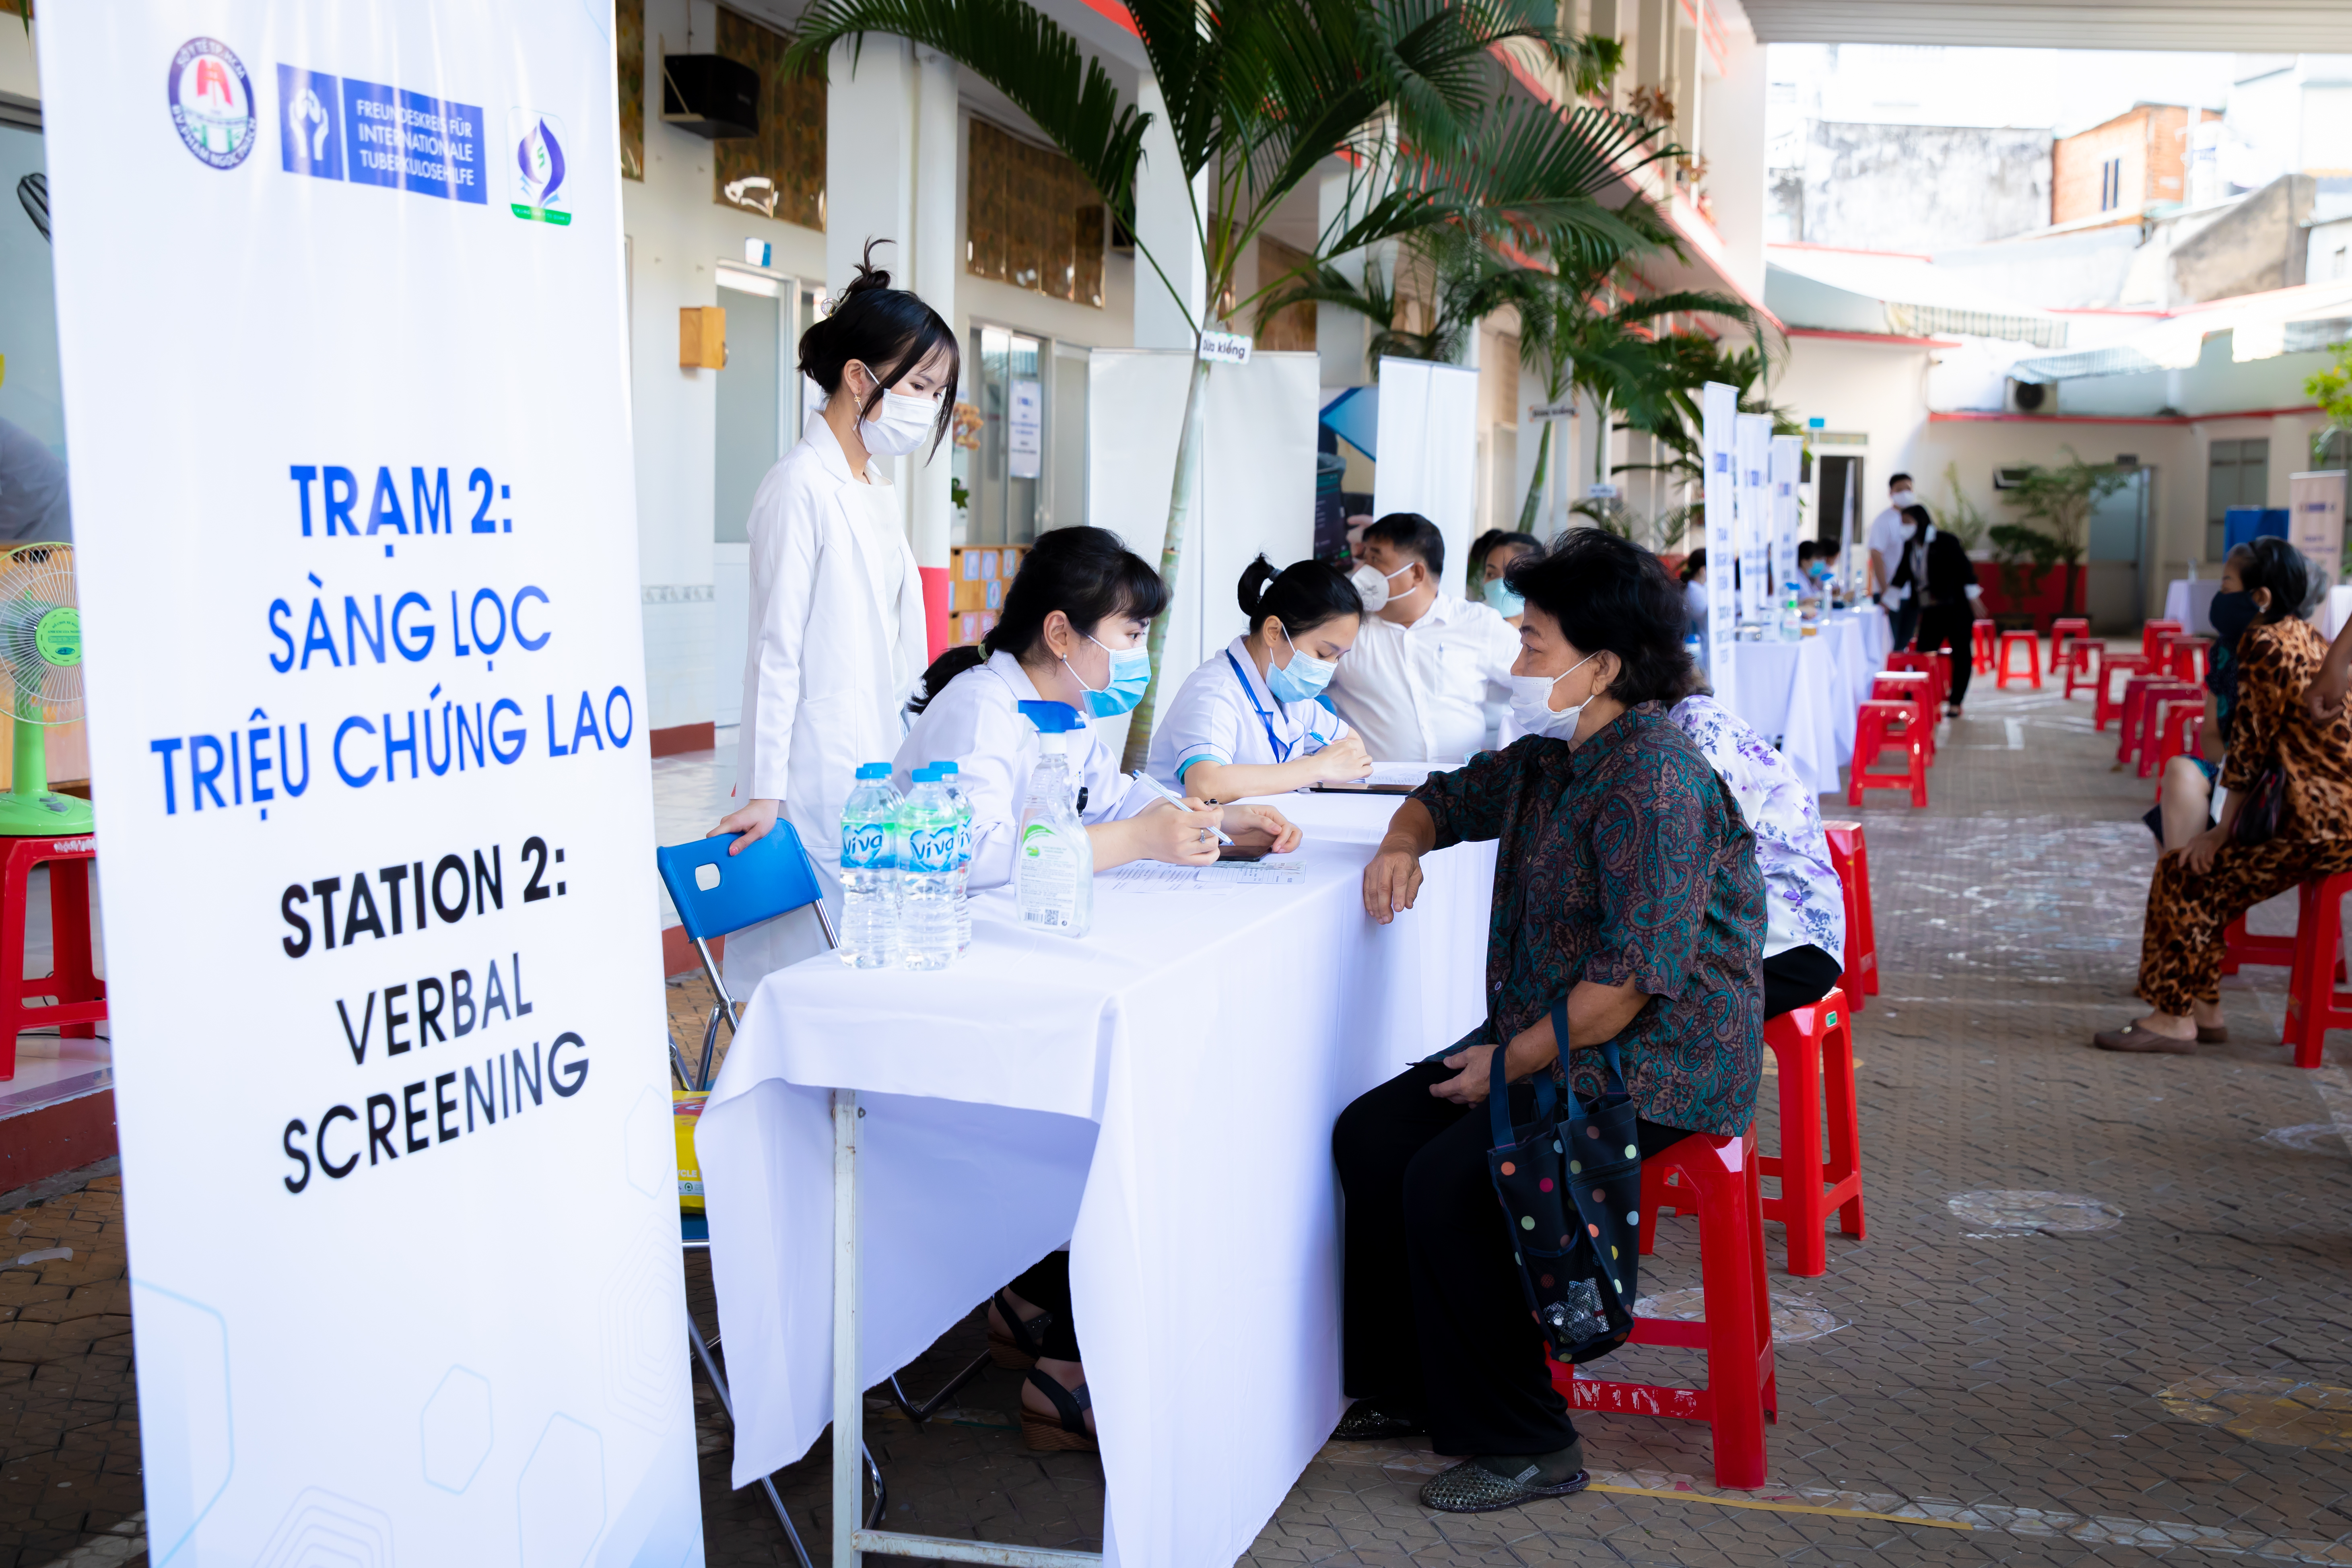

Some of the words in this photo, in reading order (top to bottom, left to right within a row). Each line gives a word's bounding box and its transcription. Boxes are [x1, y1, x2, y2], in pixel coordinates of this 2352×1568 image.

[356, 99, 447, 134] FREUNDESKREIS
[449, 117, 473, 138] FÜR
[358, 122, 474, 163] INTERNATIONALE
[359, 149, 475, 186] TUBERKULOSEHILFE
[289, 465, 452, 558] TRẠM
[468, 467, 512, 534] 2:
[268, 571, 435, 674] SÀNG
[451, 585, 552, 672] LỌC
[150, 707, 309, 821] TRIỆU
[333, 682, 527, 789] CHỨNG
[546, 685, 633, 758] LAO
[280, 844, 504, 959] STATION
[521, 836, 567, 903] 2:
[335, 952, 533, 1066] VERBAL
[282, 1032, 589, 1196] SCREENING
